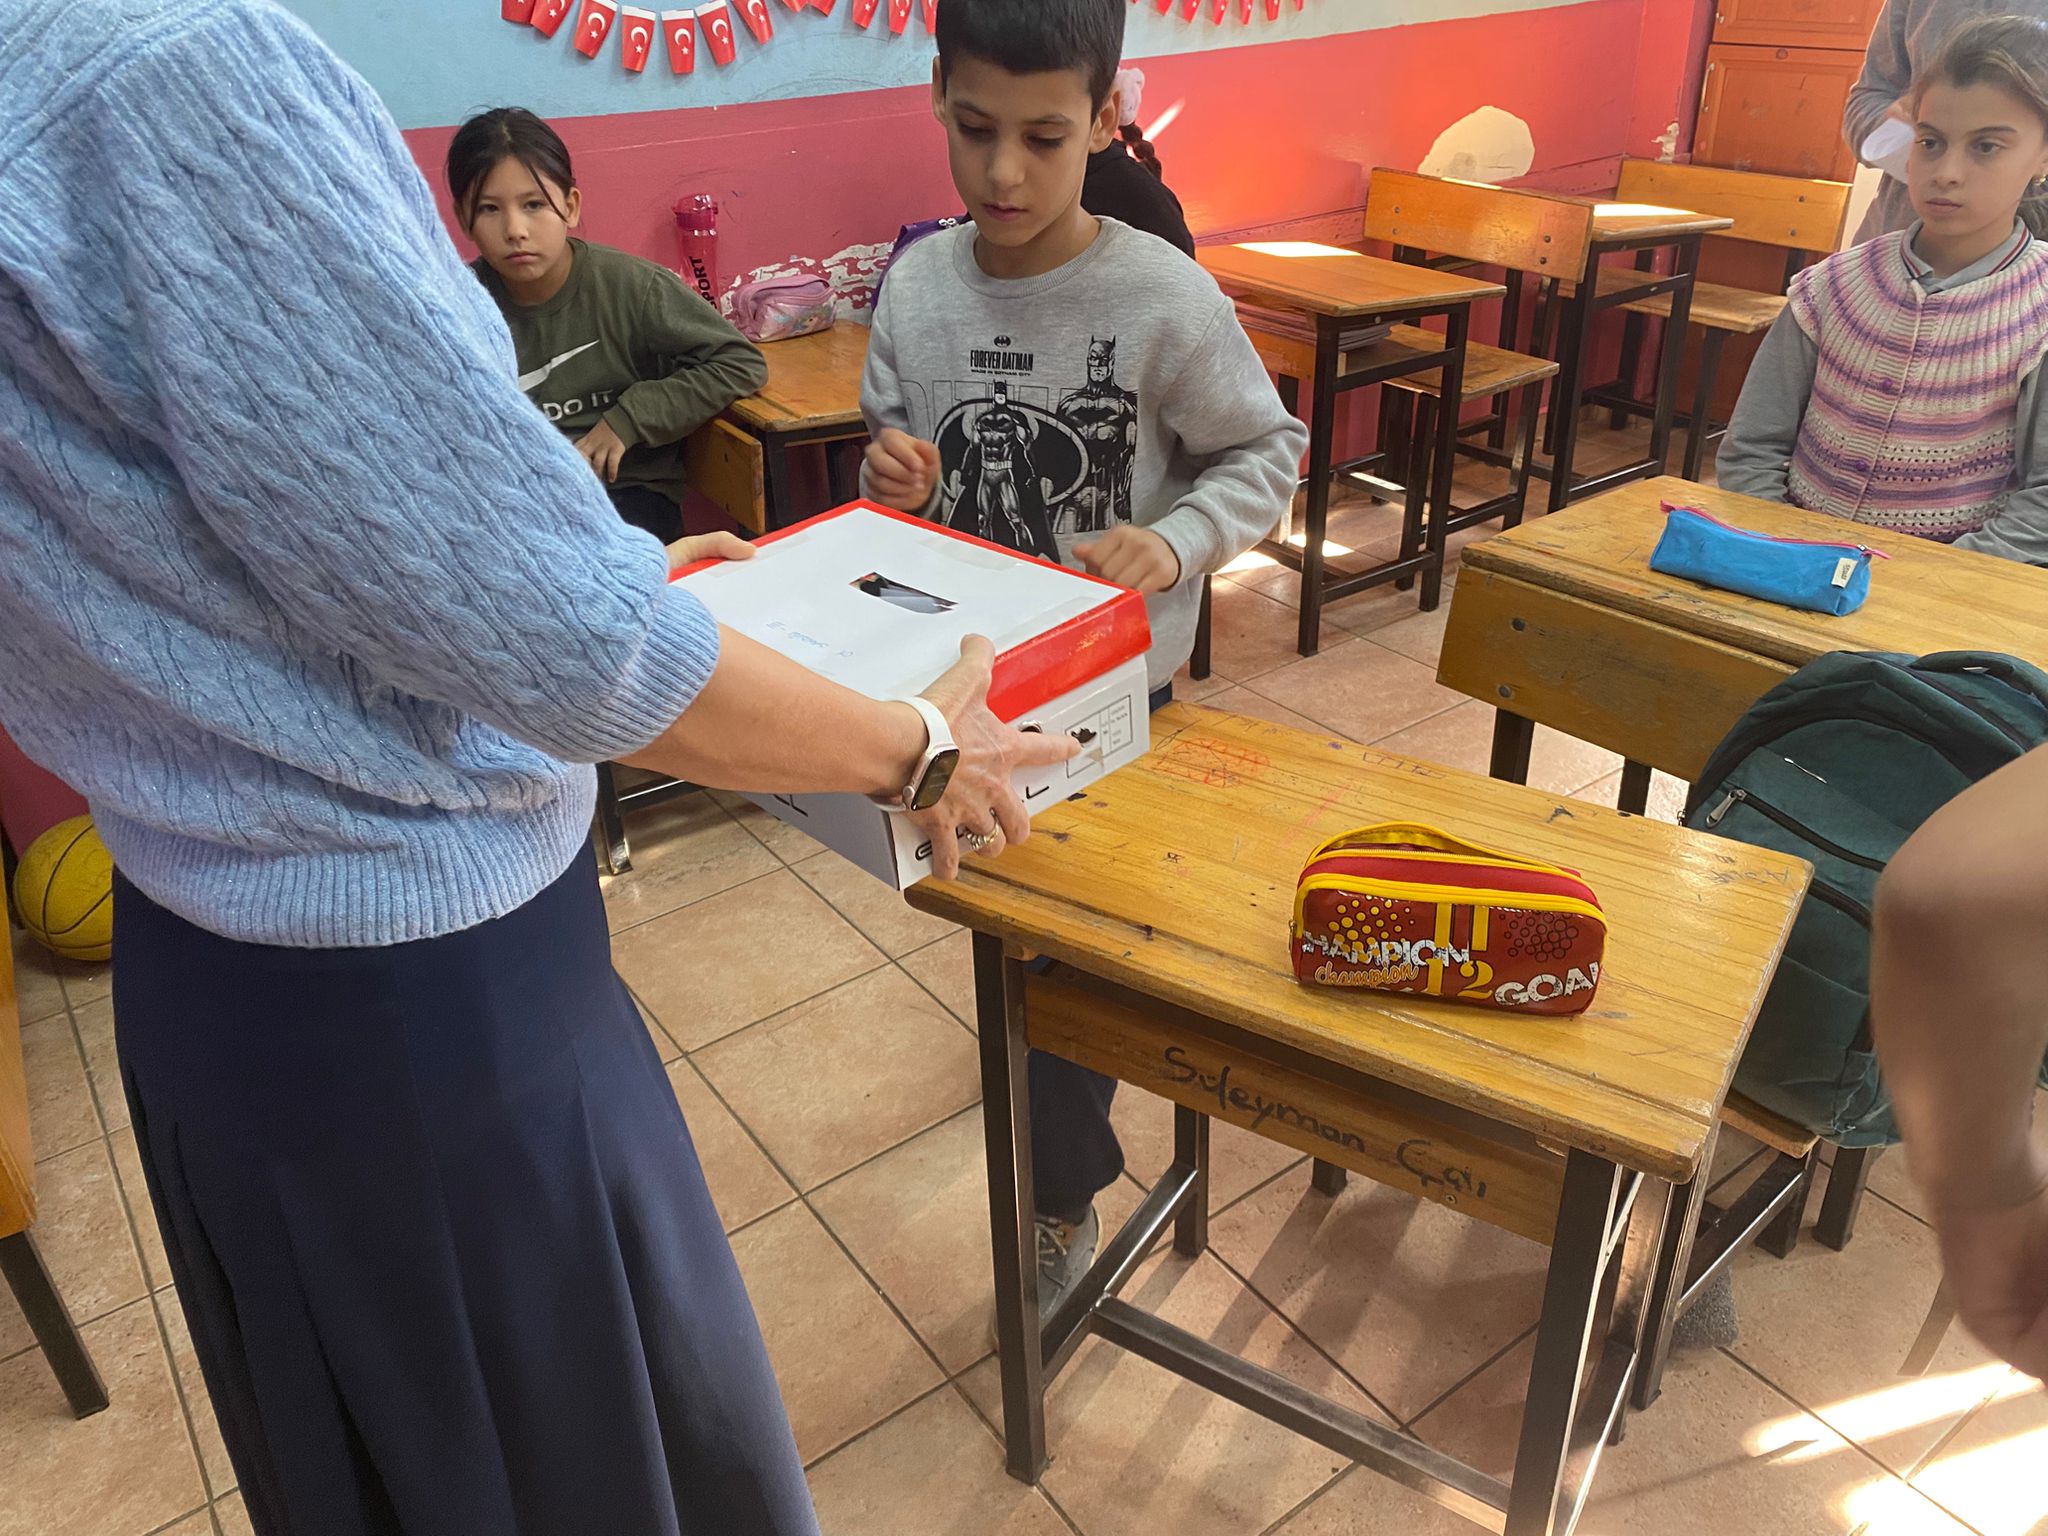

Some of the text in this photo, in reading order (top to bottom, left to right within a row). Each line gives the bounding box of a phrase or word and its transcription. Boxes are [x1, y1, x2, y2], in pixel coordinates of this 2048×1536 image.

[970, 350, 1033, 371] FOREVER BATMAN
[542, 389, 613, 421] DO IT
[1314, 961, 1419, 988] champion
